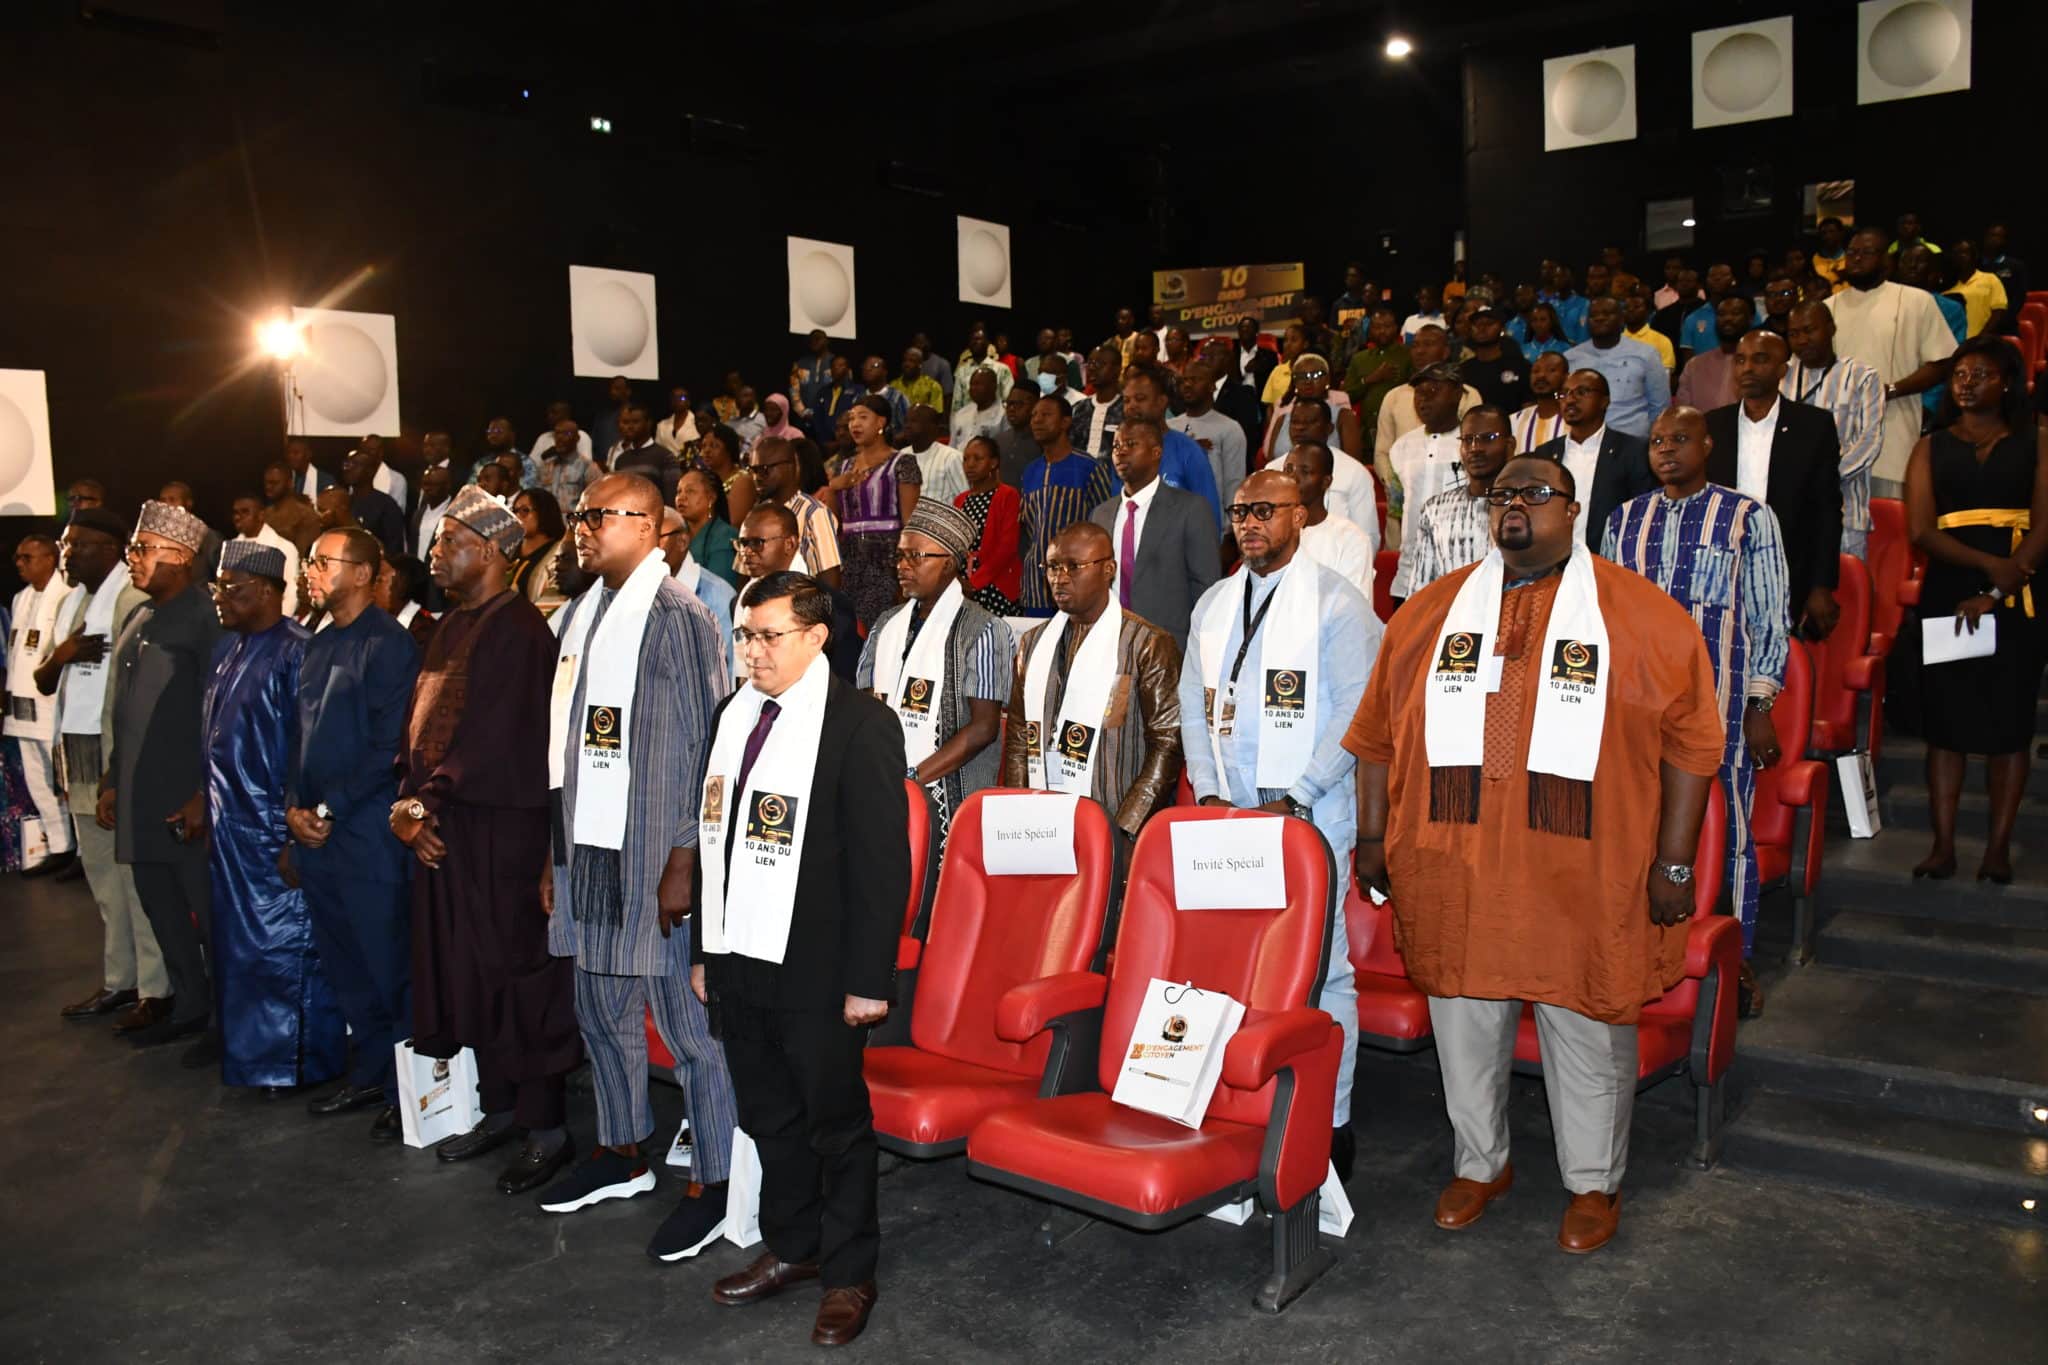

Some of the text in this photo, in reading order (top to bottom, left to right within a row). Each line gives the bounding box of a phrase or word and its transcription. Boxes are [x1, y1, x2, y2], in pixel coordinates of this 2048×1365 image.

[1221, 267, 1248, 289] 10
[1444, 685, 1462, 693] LIEN
[1550, 681, 1596, 694] 10 ANS DU
[1561, 694, 1581, 704] LIEN
[745, 841, 791, 856] 10 ANS DU
[755, 856, 776, 866] LIEN
